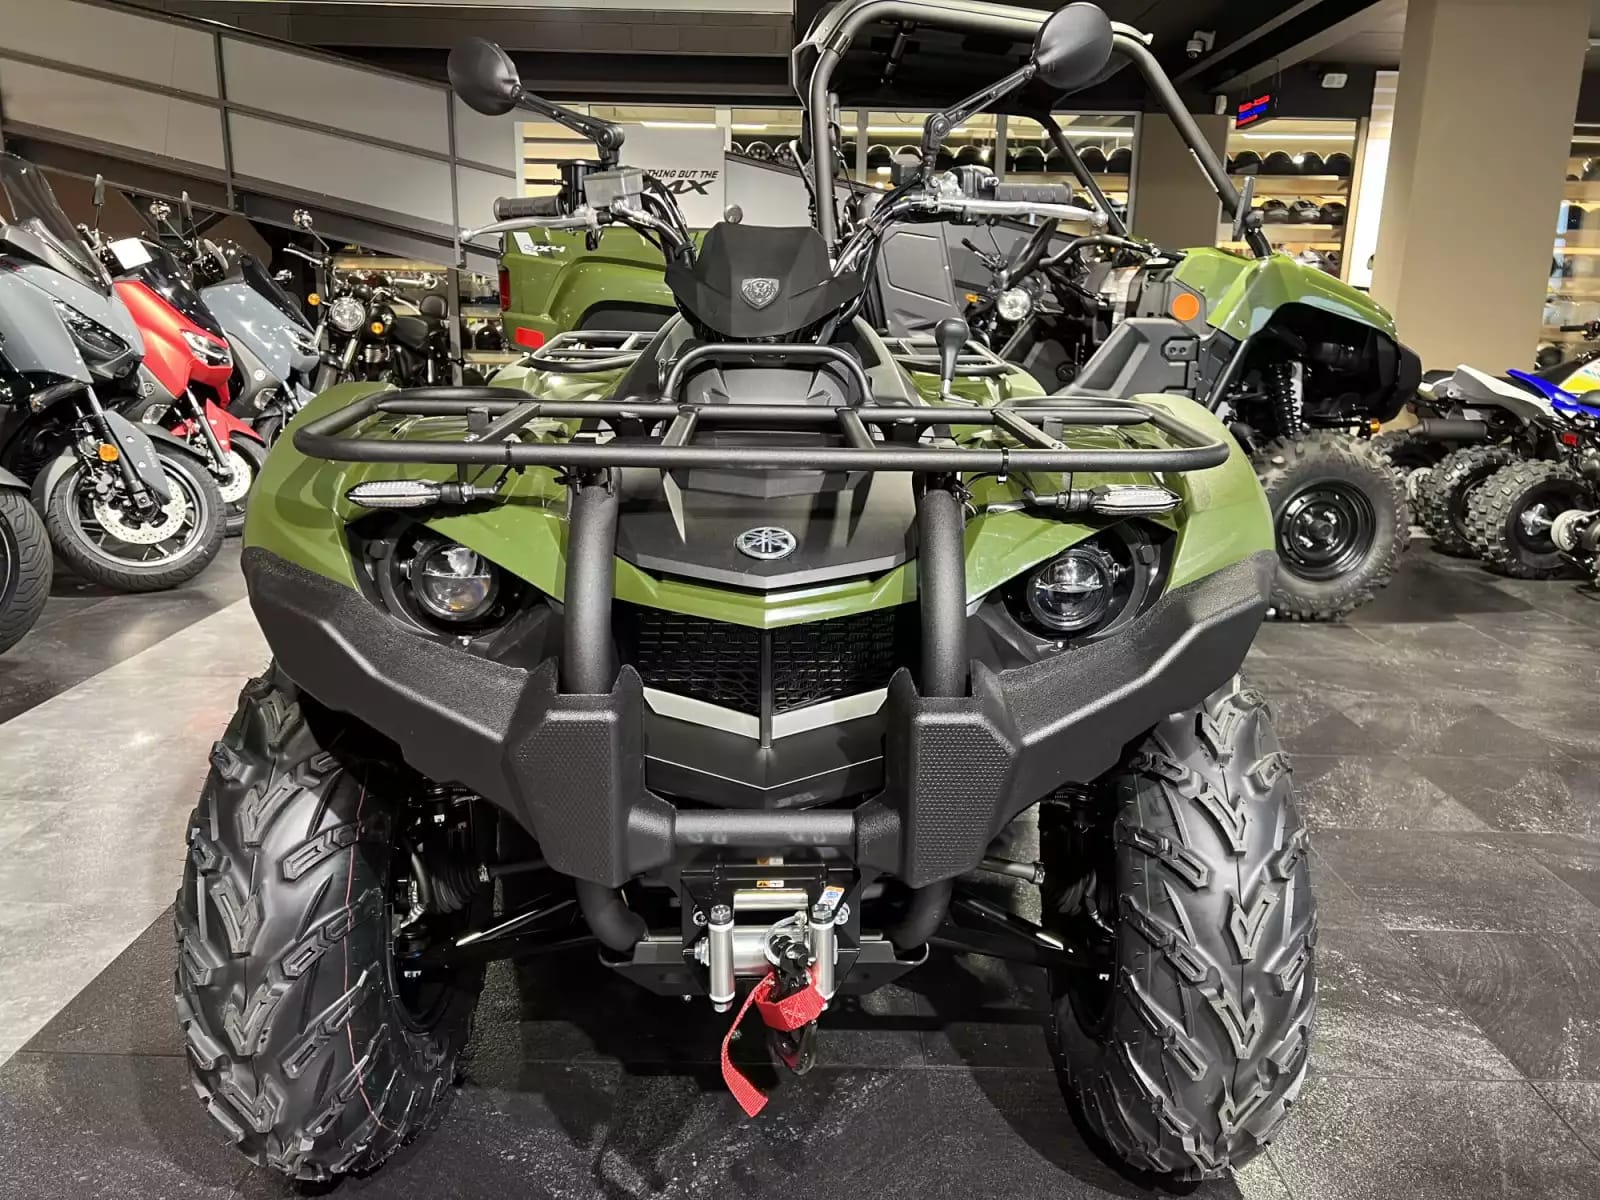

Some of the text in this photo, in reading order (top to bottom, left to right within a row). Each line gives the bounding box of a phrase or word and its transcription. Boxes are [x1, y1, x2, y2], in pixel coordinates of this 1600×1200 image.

[647, 169, 719, 179] THING BUT THE
